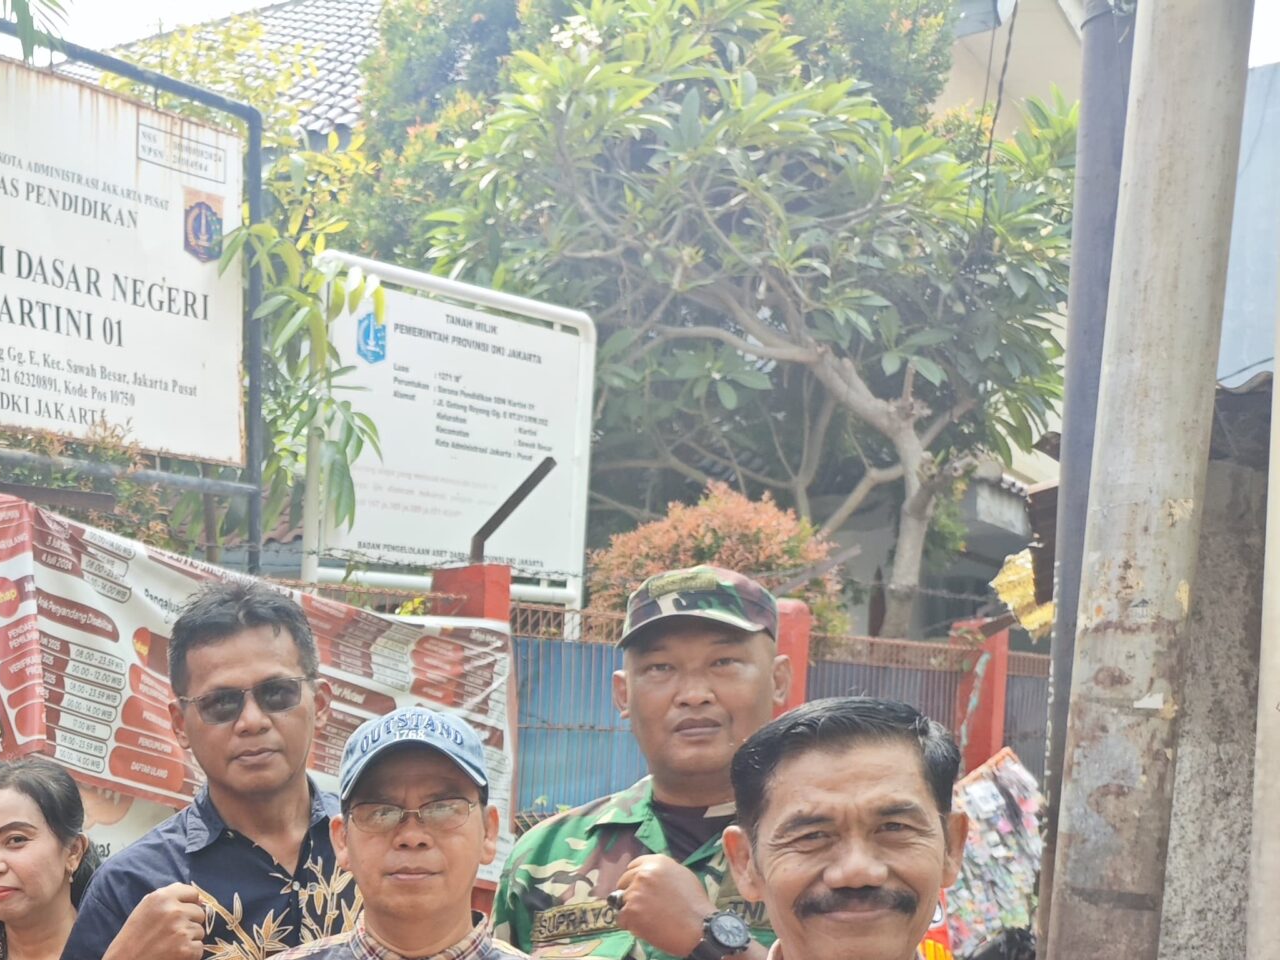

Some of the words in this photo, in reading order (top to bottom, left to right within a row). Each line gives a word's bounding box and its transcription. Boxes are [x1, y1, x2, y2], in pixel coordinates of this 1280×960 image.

[25, 181, 138, 228] PENDIDIKAN
[26, 161, 99, 190] ADMINISTRASI
[101, 182, 142, 203] JAKARTA
[144, 194, 169, 211] PUSAT
[16, 248, 102, 298] DASAR
[112, 272, 209, 321] NEGERI
[102, 316, 124, 347] 01
[445, 314, 473, 329] TANAH
[393, 323, 449, 344] PEMERINTAH
[451, 335, 490, 352] PROVINSI
[507, 348, 542, 365] JAKARTA
[43, 352, 65, 371] Kec.
[66, 358, 97, 379] Sawah
[132, 372, 169, 392] Jakarta
[171, 379, 198, 398] Pusat
[64, 380, 88, 399] Kode
[91, 386, 107, 401] Pos
[0, 391, 29, 415] DKI
[34, 398, 103, 427] JAKART
[360, 712, 465, 753] OUTSTAND
[393, 729, 426, 741] 1768
